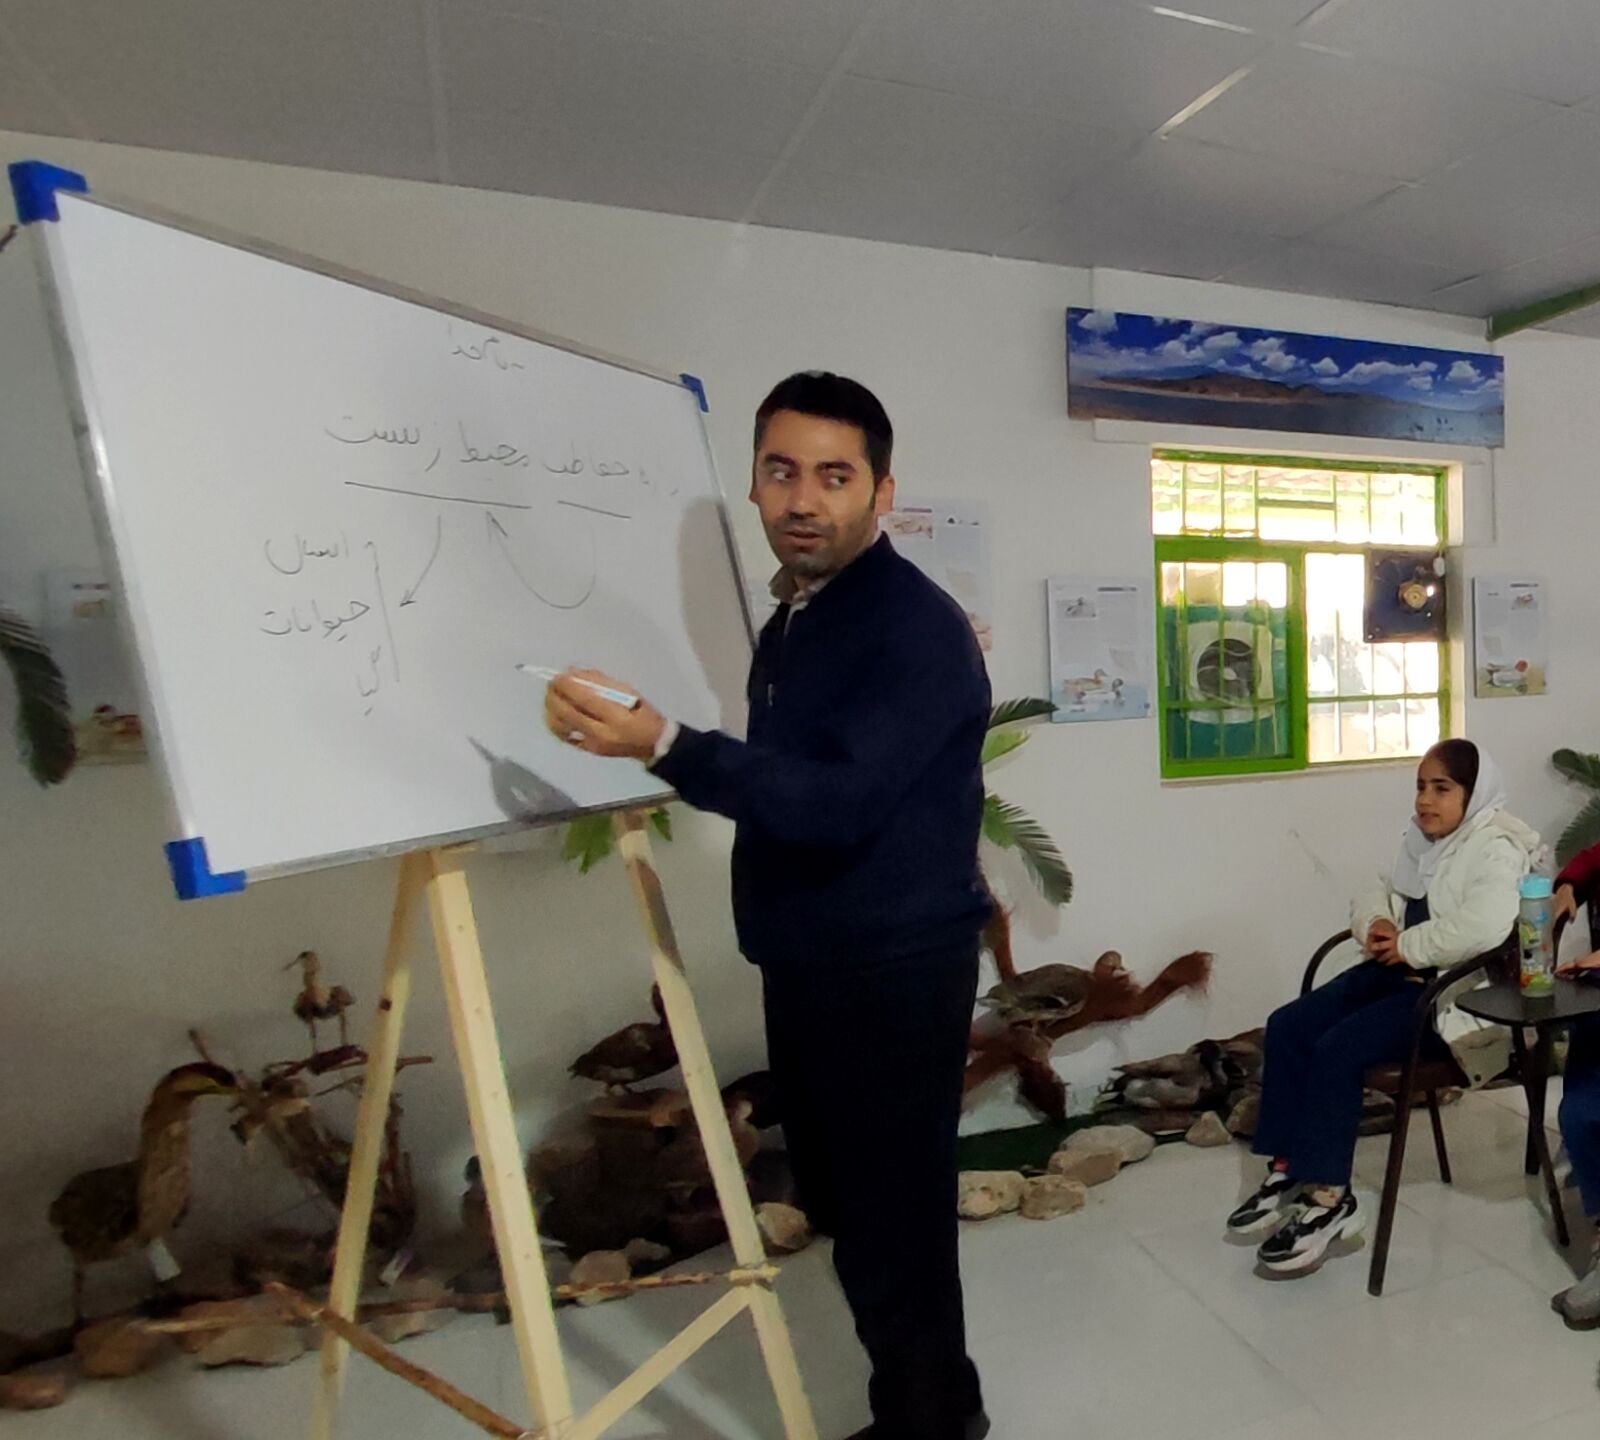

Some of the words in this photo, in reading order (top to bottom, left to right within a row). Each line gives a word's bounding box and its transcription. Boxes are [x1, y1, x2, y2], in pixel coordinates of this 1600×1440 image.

[324, 415, 441, 474] زیست
[459, 419, 529, 482] محیط
[249, 598, 371, 642] حیوانات
